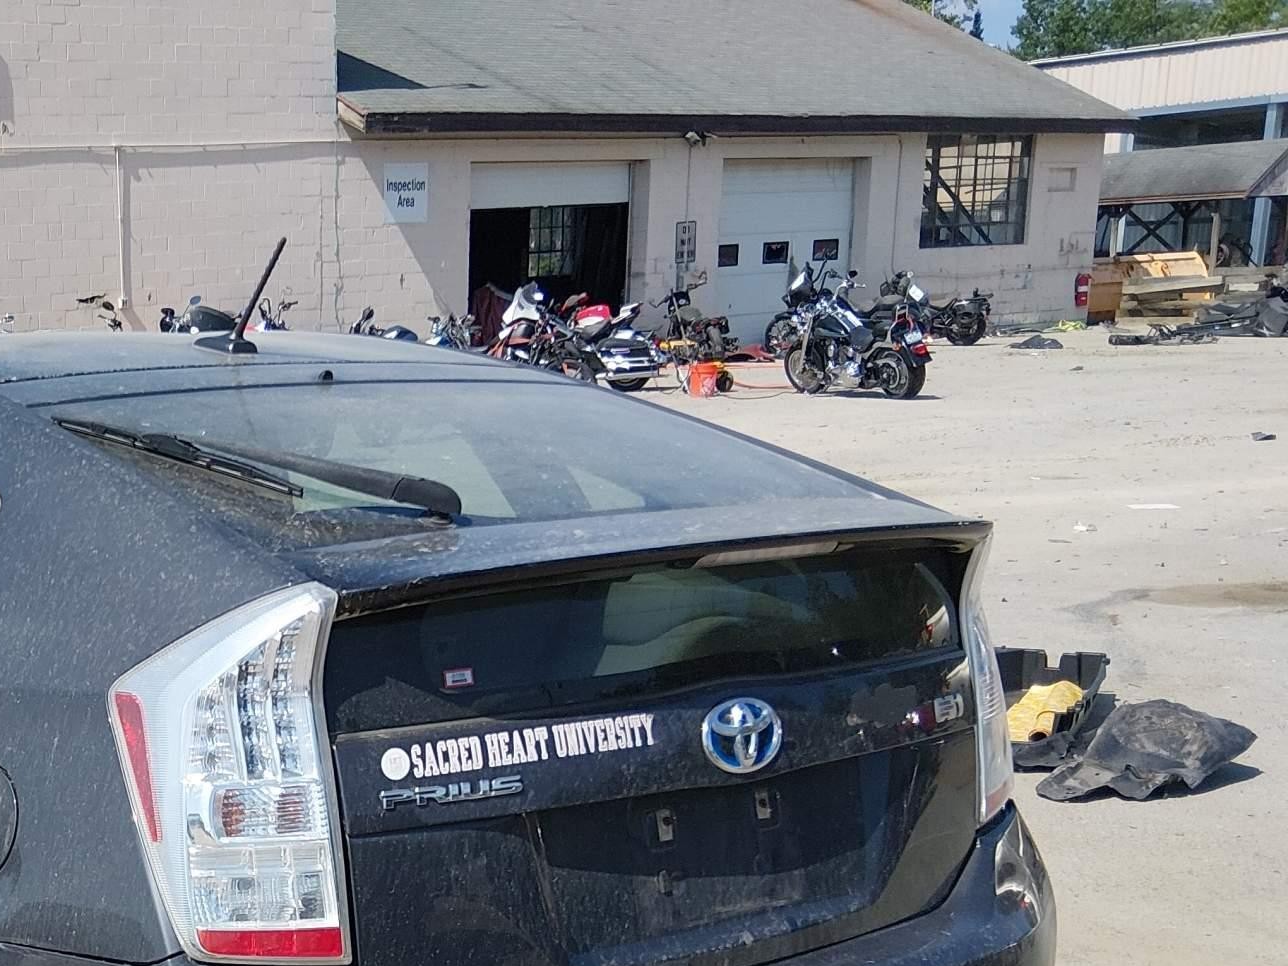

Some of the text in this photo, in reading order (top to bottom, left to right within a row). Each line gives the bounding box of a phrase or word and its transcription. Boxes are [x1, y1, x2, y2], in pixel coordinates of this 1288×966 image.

[386, 178, 426, 194] Inspection
[397, 195, 415, 208] Area
[680, 238, 691, 246] NT
[411, 713, 654, 778] SACRED HEART UNIVERSITY
[379, 774, 524, 810] PRIUS
